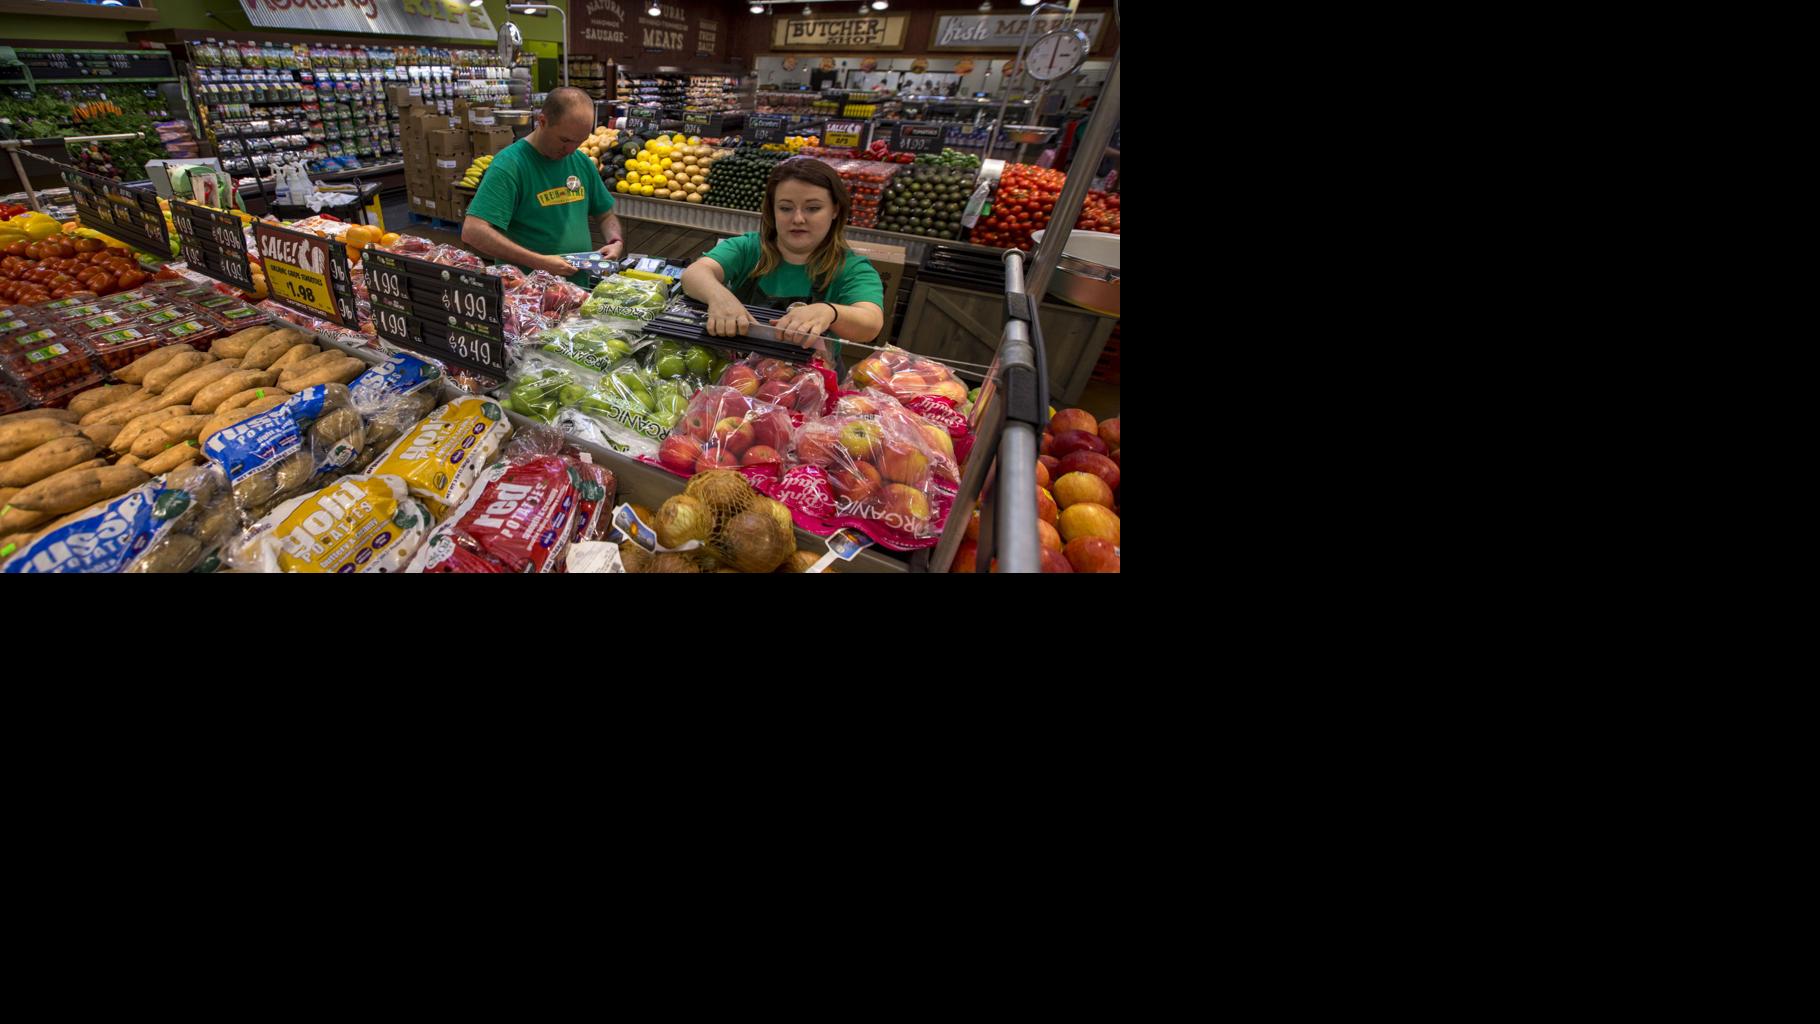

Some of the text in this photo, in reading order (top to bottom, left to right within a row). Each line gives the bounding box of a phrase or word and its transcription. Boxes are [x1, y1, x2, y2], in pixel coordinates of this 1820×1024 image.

[643, 28, 684, 51] MEATS
[793, 19, 878, 37] BUTCHER
[826, 36, 876, 45] SHOP
[940, 16, 988, 45] fish
[261, 234, 298, 264] SALE!
[607, 405, 671, 441] RGANIC
[280, 481, 367, 555] gold
[473, 483, 533, 528] red
